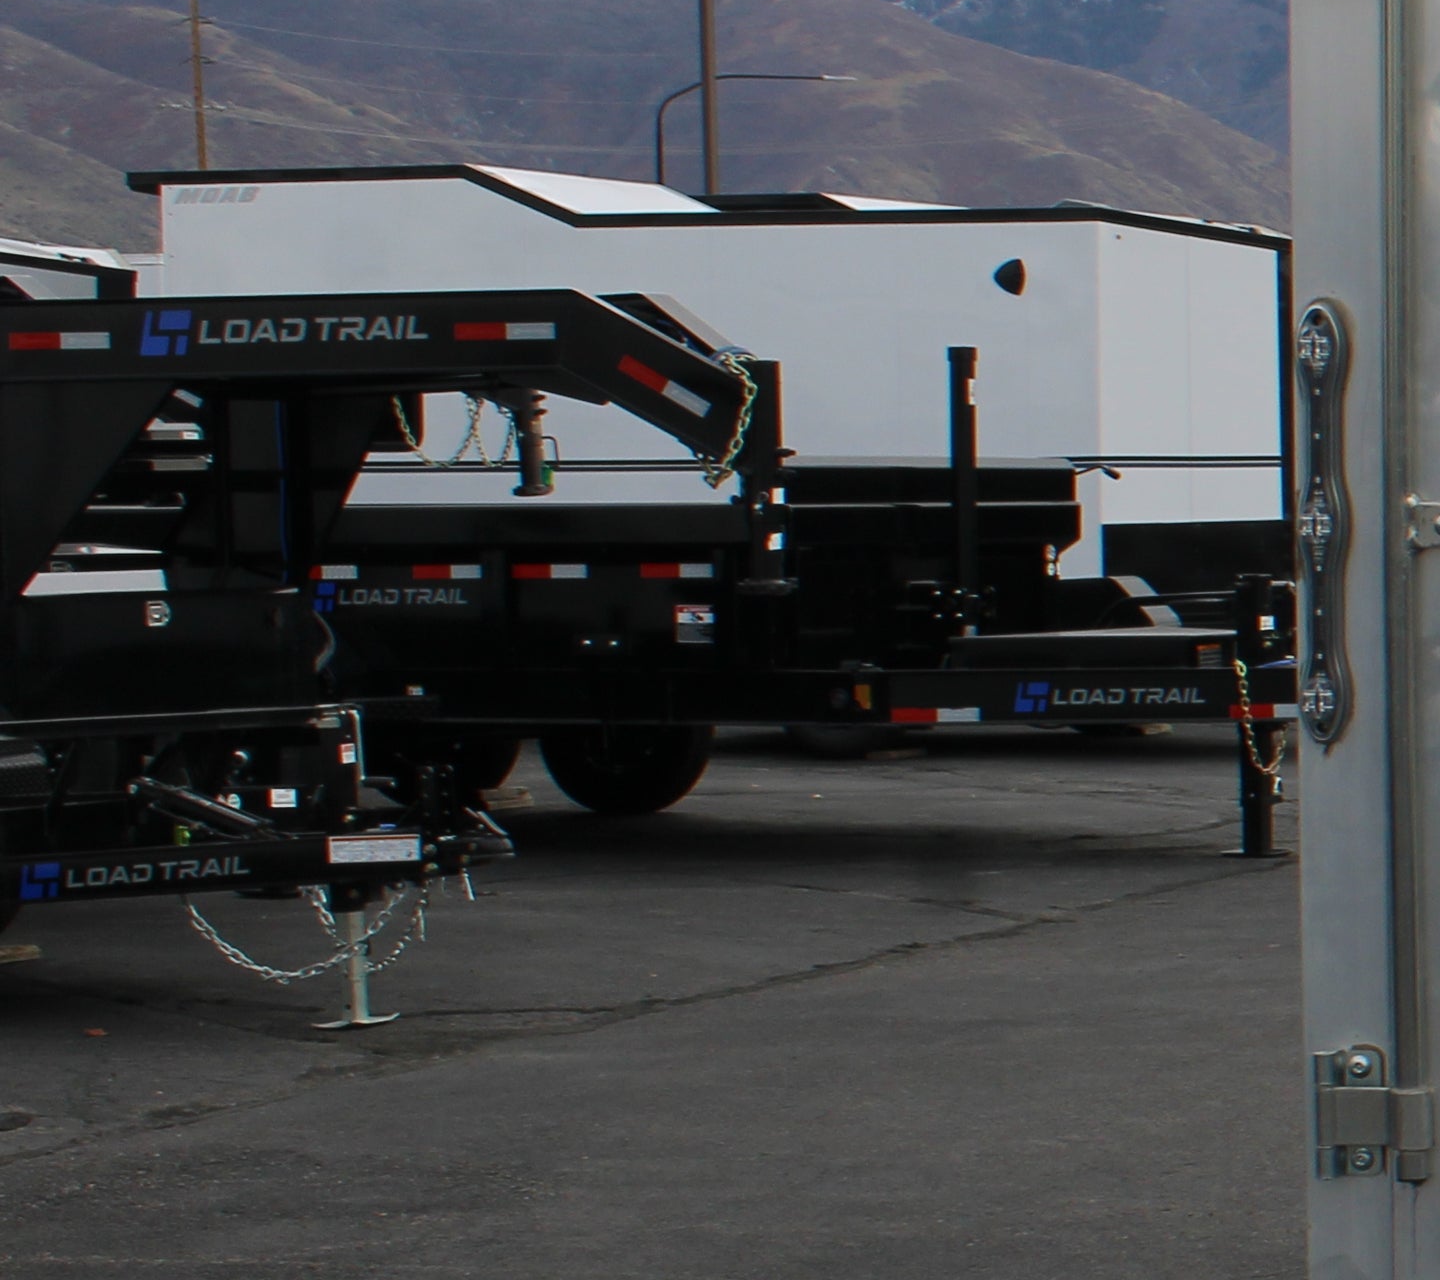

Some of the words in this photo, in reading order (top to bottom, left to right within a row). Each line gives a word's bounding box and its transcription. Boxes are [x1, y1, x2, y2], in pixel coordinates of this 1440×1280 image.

[174, 186, 261, 204] MOAB
[197, 318, 307, 344] LOAD
[314, 316, 429, 341] TRAIL
[338, 588, 399, 605] LOAD
[403, 587, 468, 604] TRAIL
[1051, 688, 1125, 705] LOAD
[1130, 687, 1206, 704] TRAIL
[66, 863, 153, 888] LOAD
[159, 855, 250, 880] TRAIL
